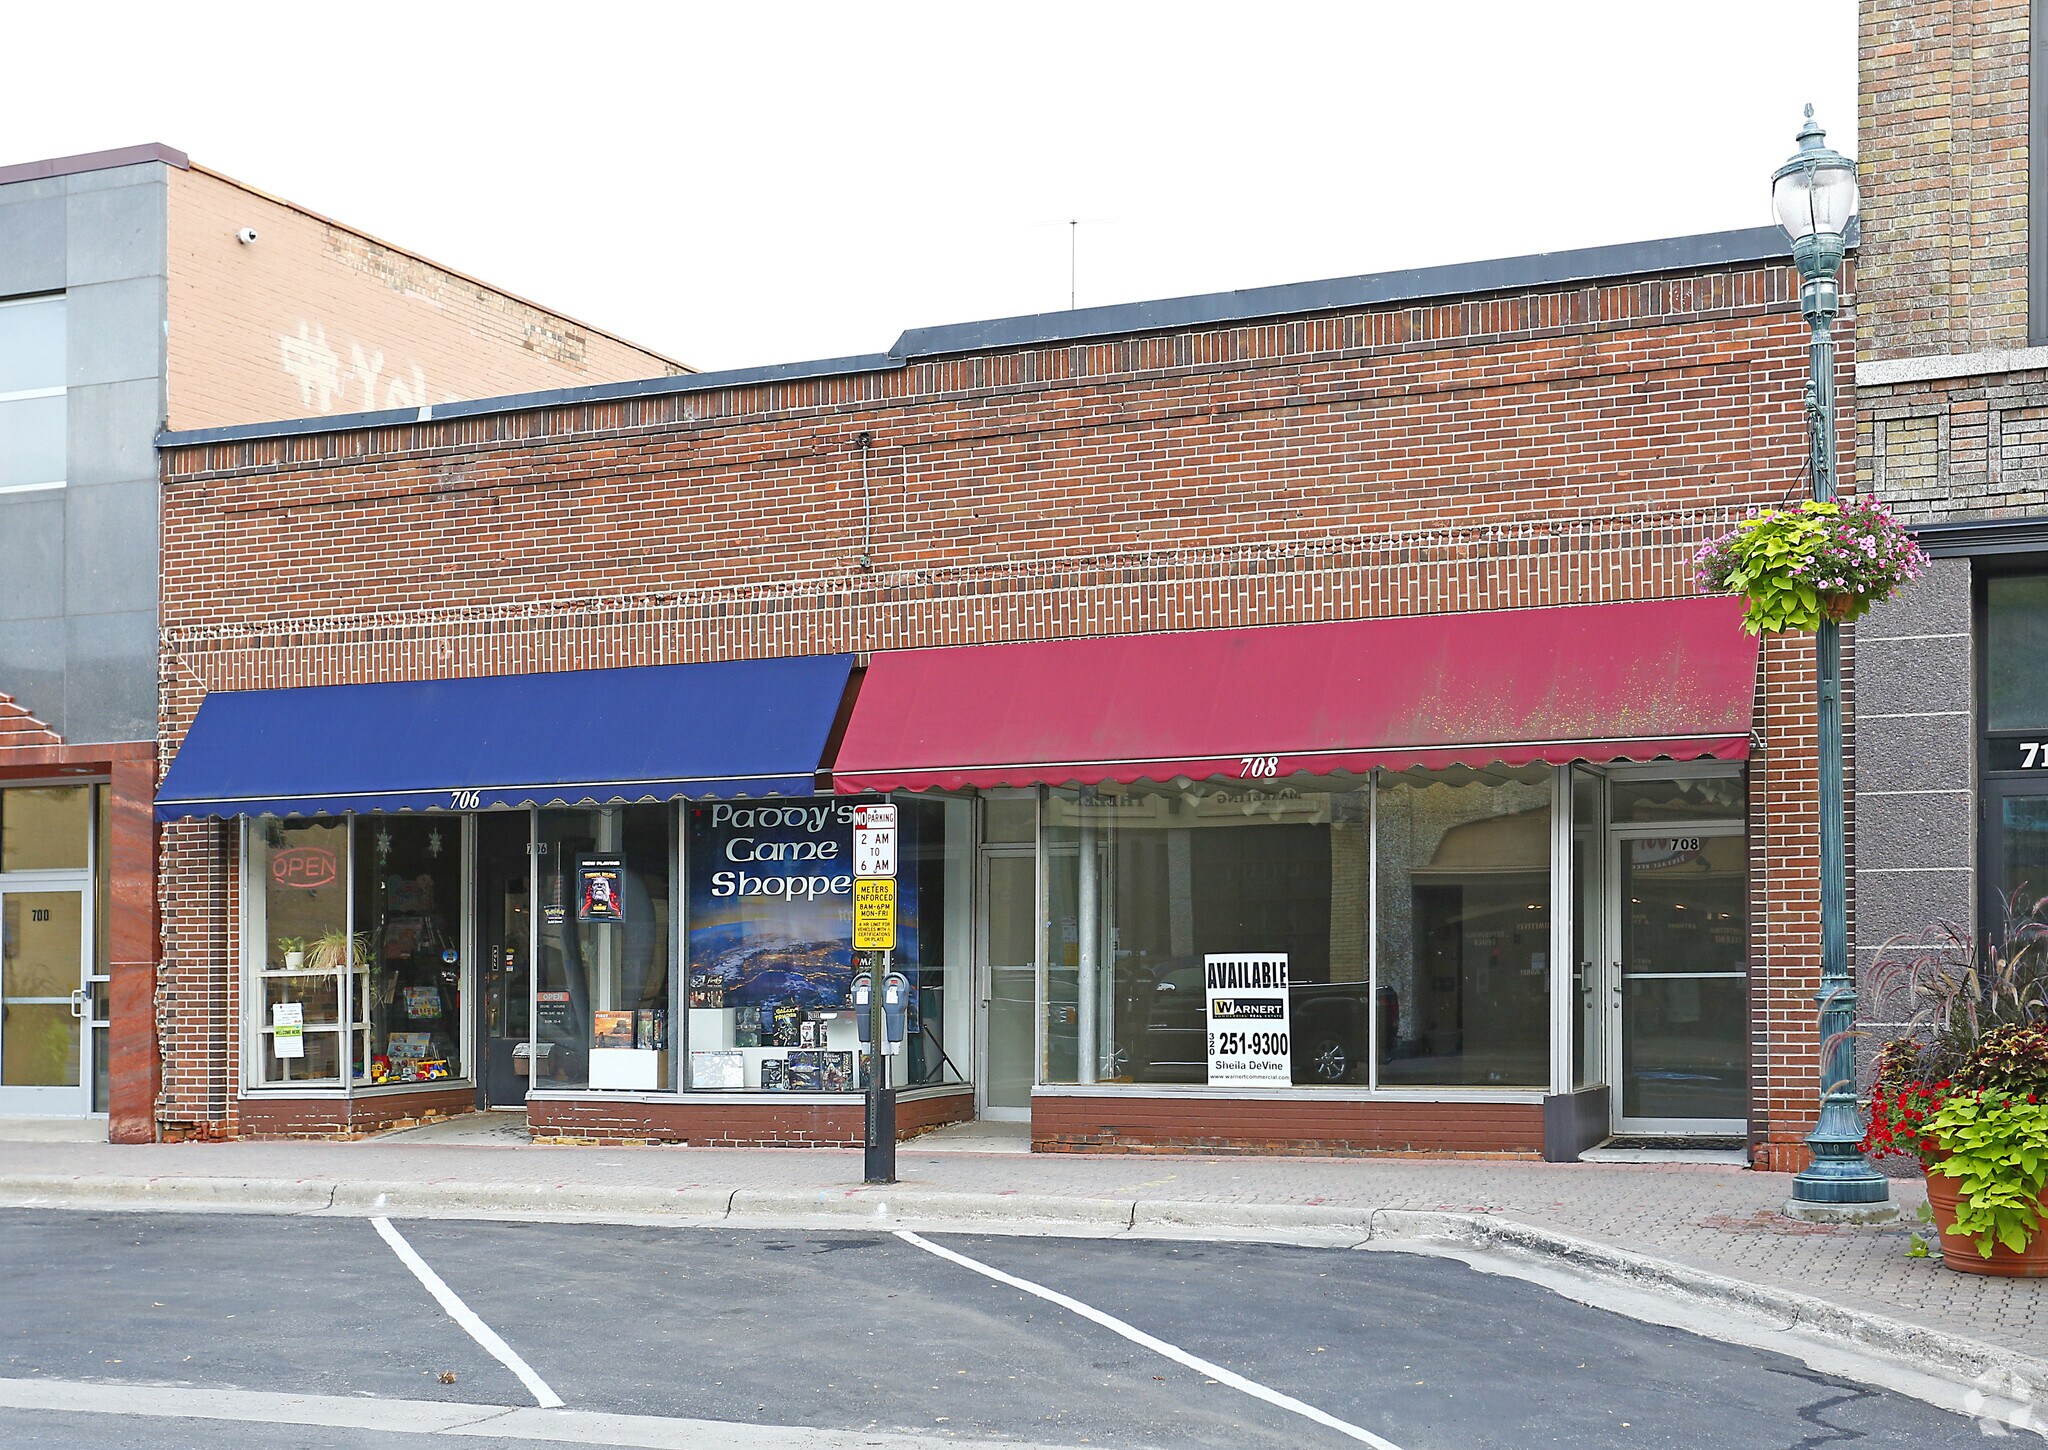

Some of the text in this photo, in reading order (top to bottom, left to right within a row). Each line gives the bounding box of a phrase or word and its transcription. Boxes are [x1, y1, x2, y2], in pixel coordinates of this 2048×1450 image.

[1240, 757, 1278, 778] 708
[450, 790, 480, 809] 706
[856, 812, 893, 825] NO PARKING
[862, 834, 889, 844] 2 AM
[1671, 839, 1699, 850] 708
[726, 838, 838, 862] Game
[870, 848, 880, 856] TO
[273, 856, 336, 877] OPEN
[861, 860, 889, 871] 6 AM
[712, 872, 852, 901] Shoppe
[32, 909, 49, 921] 700
[1208, 962, 1286, 989] AVAILABLE
[1216, 1001, 1282, 1014] WARNERT
[1220, 1032, 1288, 1055] 251-9300
[1215, 1061, 1283, 1070] Sheila DeVine
